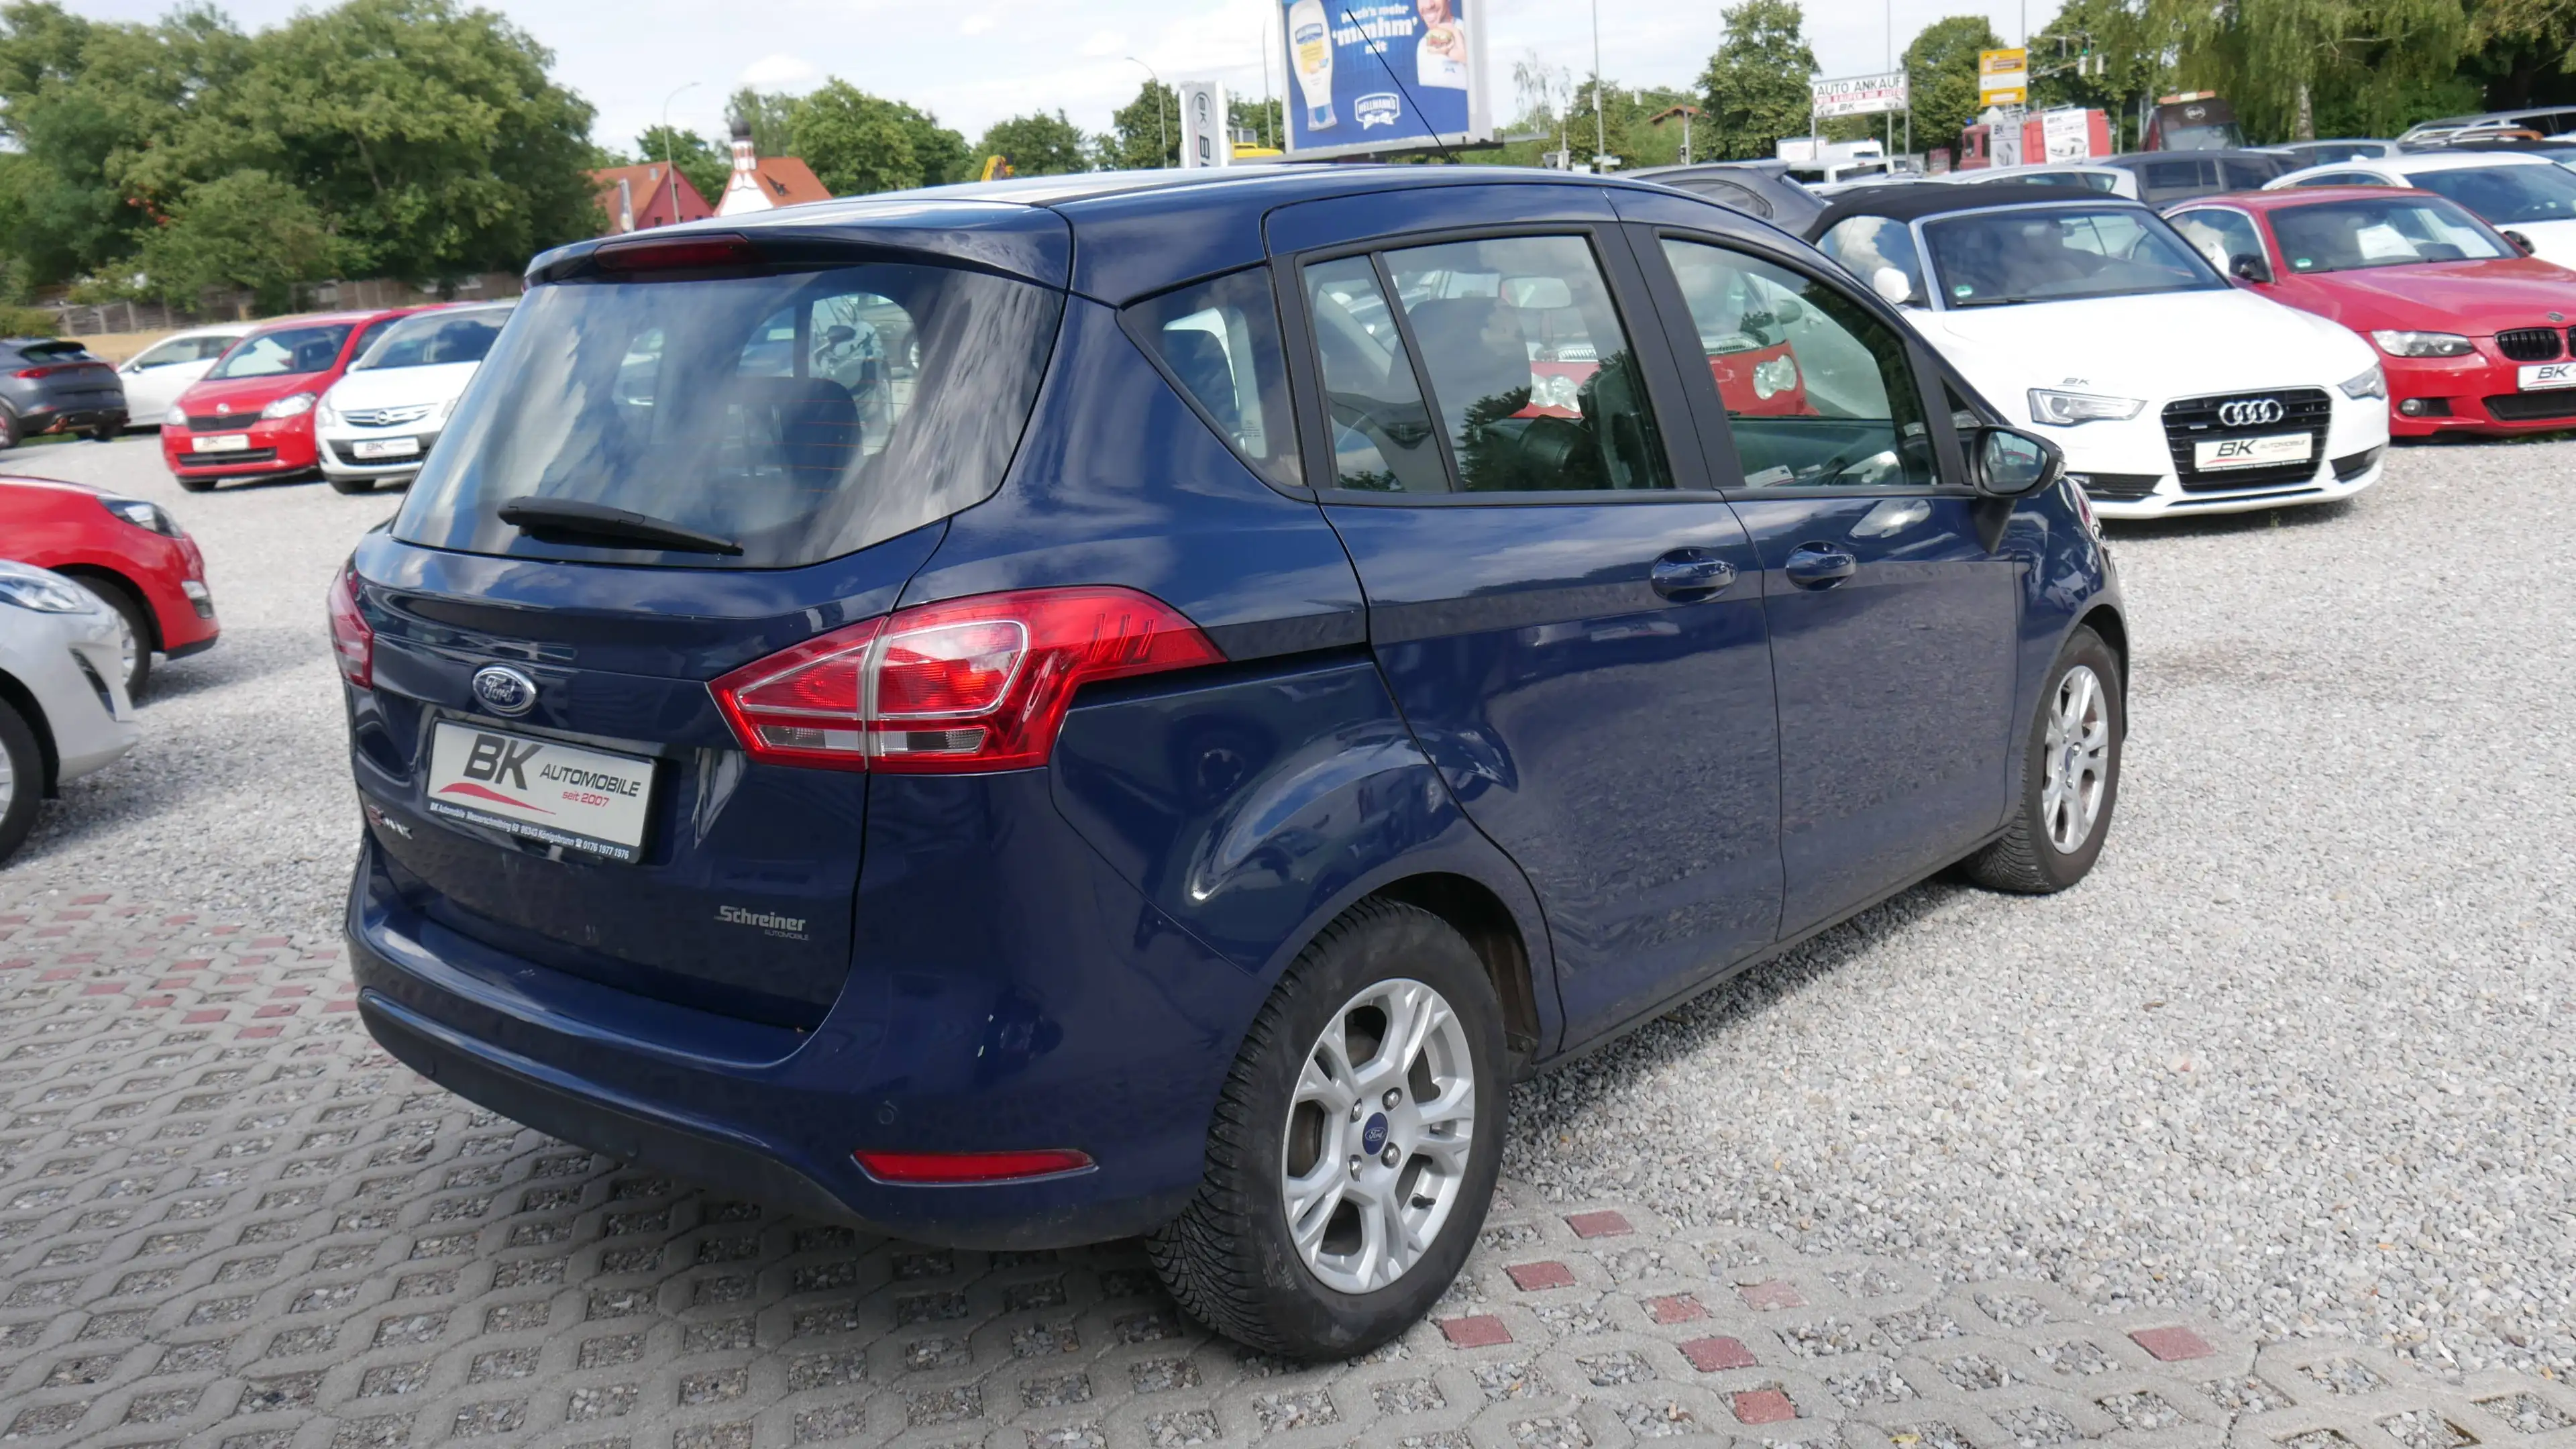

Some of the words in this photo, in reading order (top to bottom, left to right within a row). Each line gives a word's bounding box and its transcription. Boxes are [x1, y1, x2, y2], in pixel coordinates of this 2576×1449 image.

[1817, 83, 1849, 96] AUTO
[1854, 76, 1902, 92] ANKAUF
[2537, 365, 2571, 379] BK
[2062, 377, 2090, 386] BK
[2216, 440, 2259, 458] BK
[483, 675, 516, 703] Ford
[463, 733, 544, 791] BK
[539, 763, 642, 798] AUTOMOBILE
[561, 790, 580, 802] seit
[580, 792, 610, 808] 2007
[429, 802, 439, 811] BK
[538, 828, 575, 847] Königsbrunn
[583, 840, 598, 852] 0176
[598, 844, 614, 855] 1977
[614, 848, 630, 859] 1976
[719, 905, 806, 932] Schreiner
[764, 928, 809, 941] AUTOMOBILE
[1368, 1129, 1385, 1140] Ford
